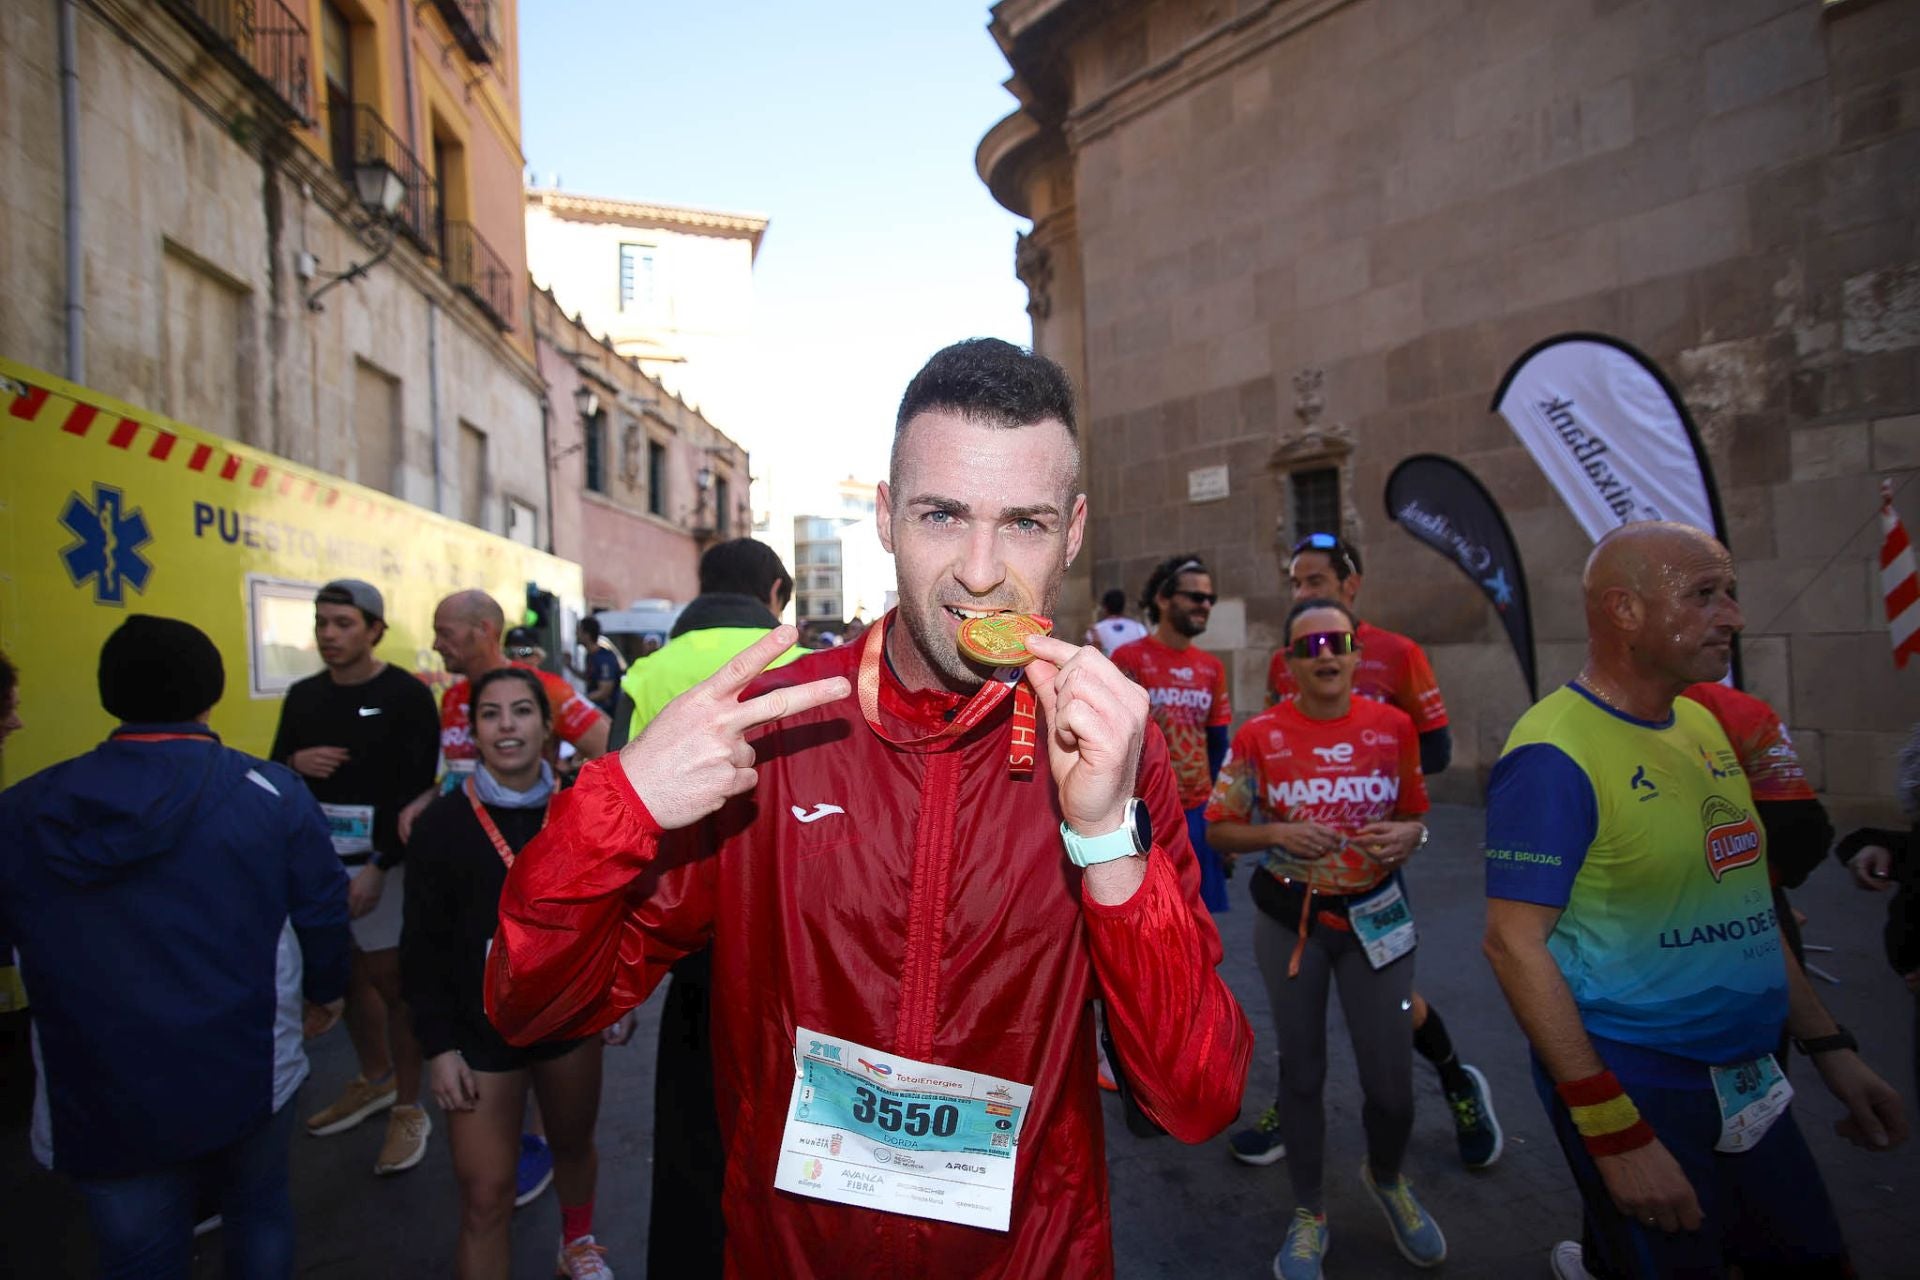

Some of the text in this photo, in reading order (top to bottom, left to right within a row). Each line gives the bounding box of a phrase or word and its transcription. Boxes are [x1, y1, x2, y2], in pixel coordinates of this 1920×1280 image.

[193, 501, 318, 560] PUESTO
[1267, 769, 1400, 808] MARATÓN
[1514, 851, 1562, 866] BRUJAS
[1659, 919, 1746, 949] LLANO
[1744, 911, 1769, 937] DE
[809, 1040, 842, 1061] 21K
[896, 1073, 963, 1090] TotalEnergies
[853, 1086, 959, 1137] 3550
[884, 1135, 919, 1148] DORDA
[945, 1162, 986, 1174] ARGIUS
[841, 1169, 884, 1185] AVANZA
[846, 1180, 875, 1193] FIBRA
